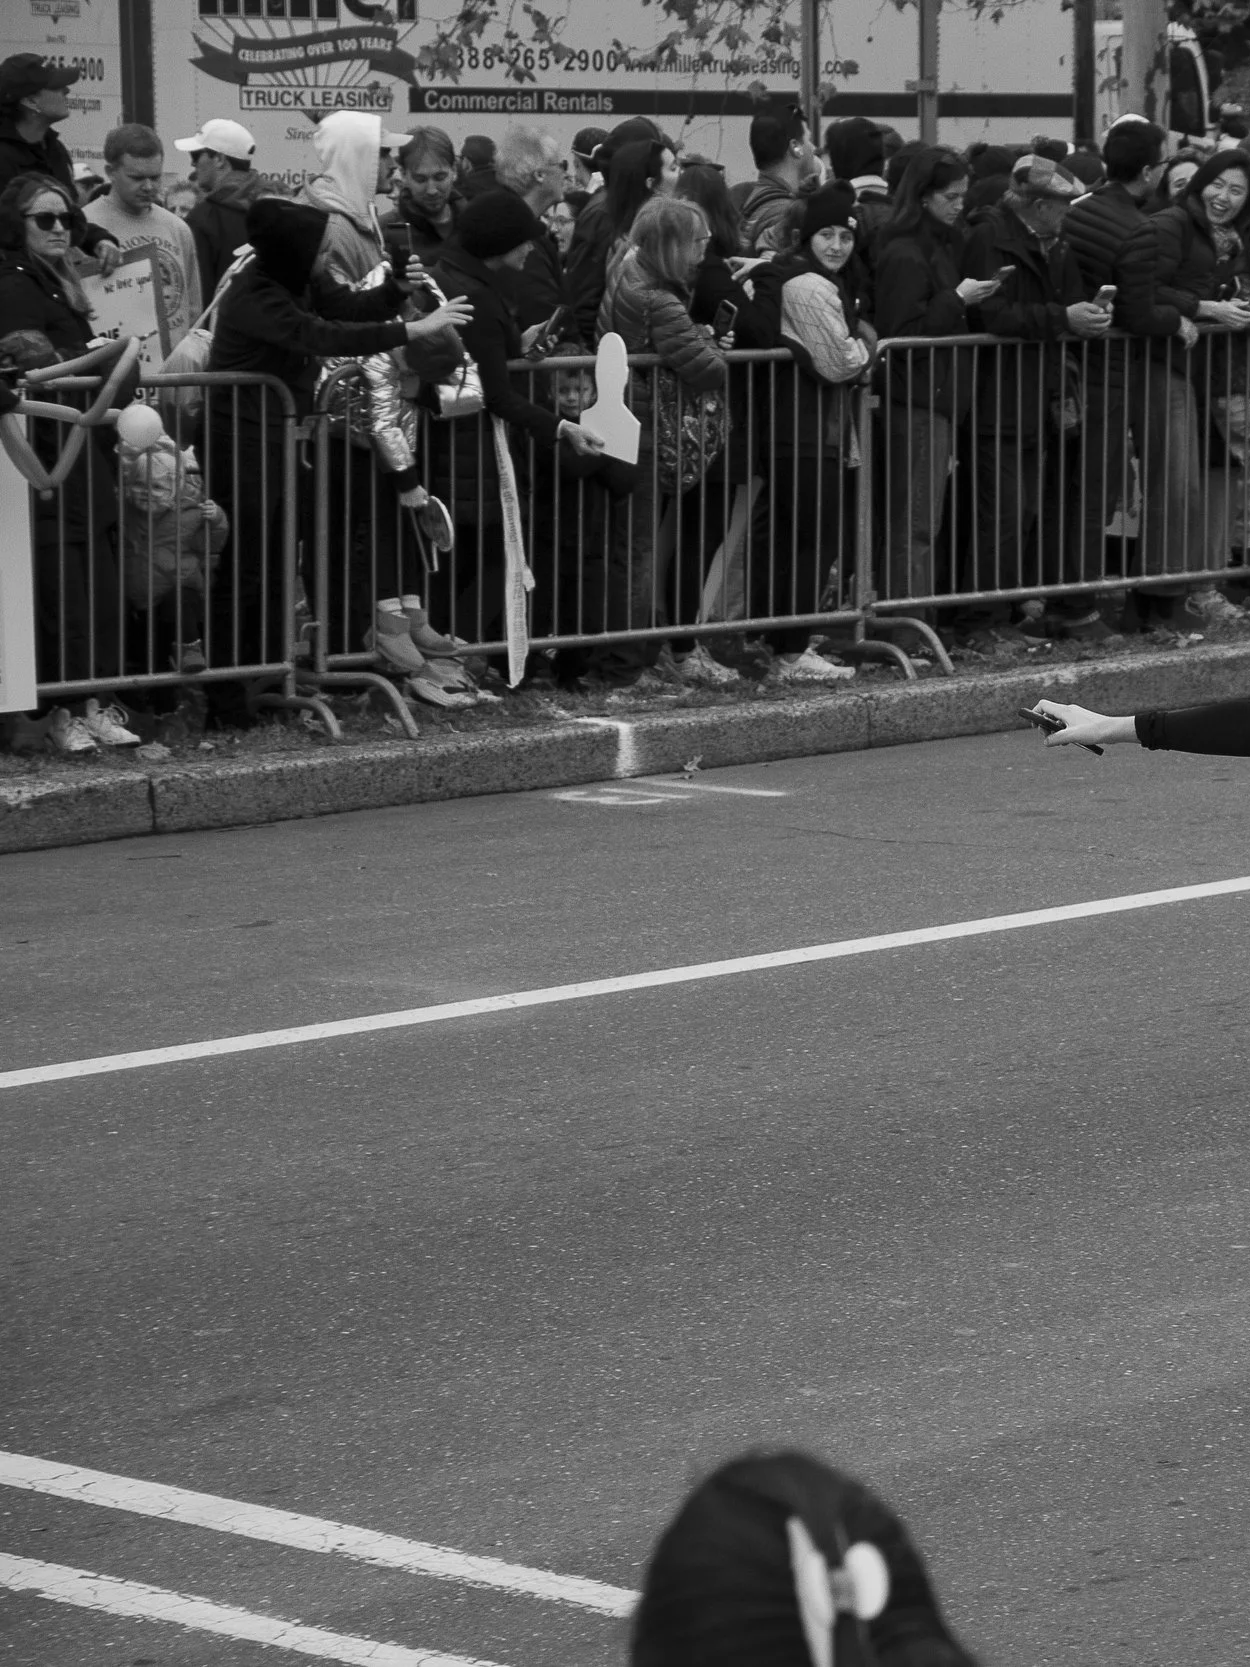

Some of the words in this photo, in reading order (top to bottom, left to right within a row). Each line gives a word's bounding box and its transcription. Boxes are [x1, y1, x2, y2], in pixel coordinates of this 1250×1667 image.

[238, 46, 304, 62] CELEBRATING
[306, 41, 334, 56] OVER
[337, 38, 358, 51] 100
[359, 37, 393, 51] YEARS
[243, 90, 305, 107] TRUCK
[311, 91, 388, 108] LEASING
[424, 90, 538, 110] Commercial
[544, 91, 614, 112] Rentals
[285, 127, 314, 141] Sinc
